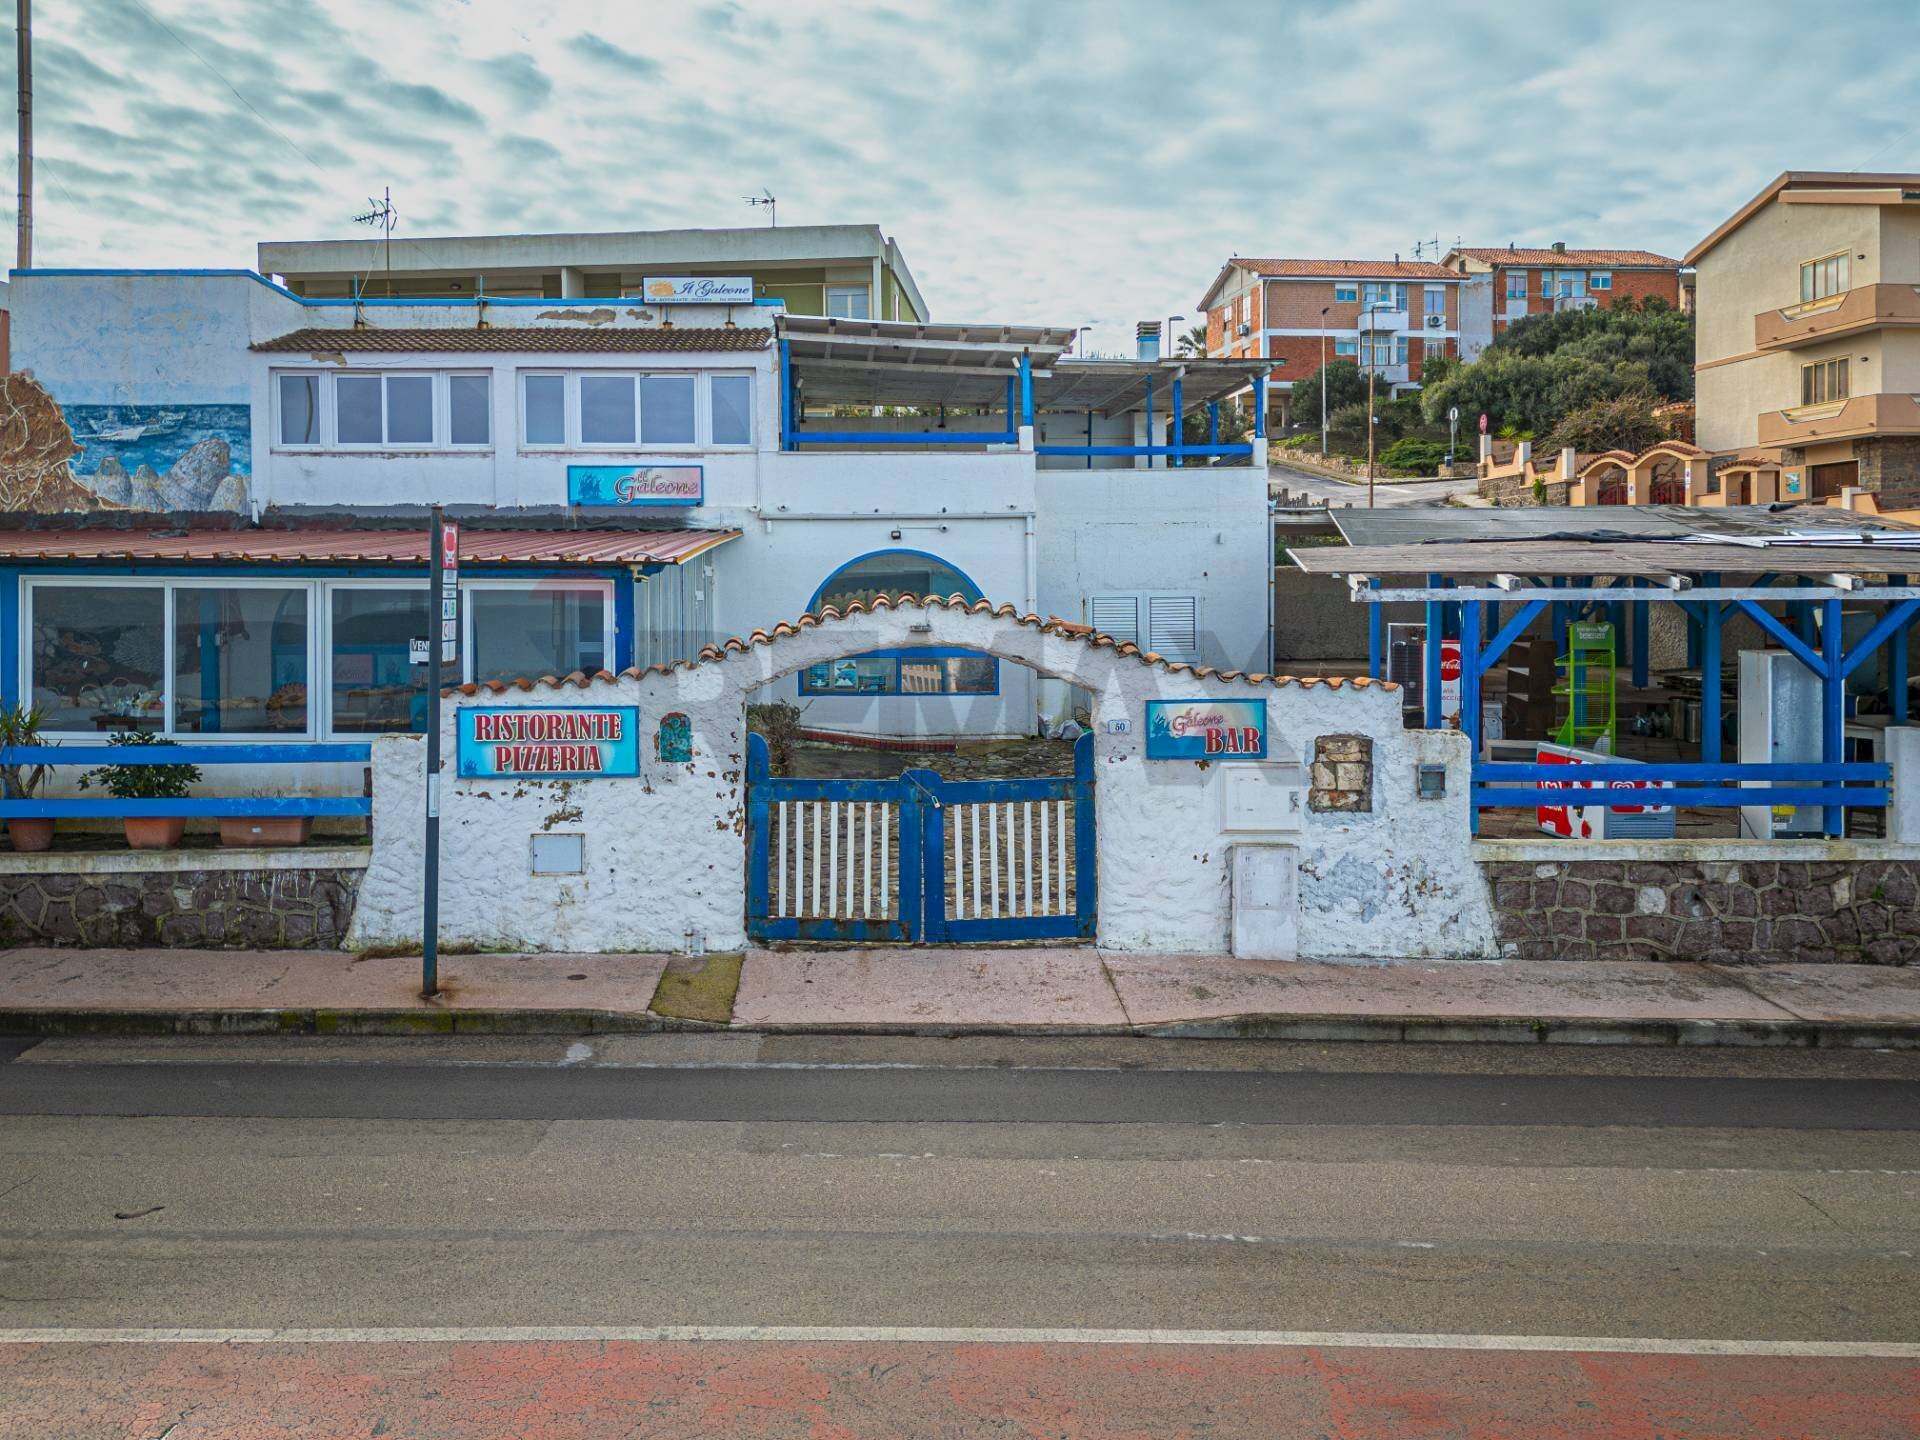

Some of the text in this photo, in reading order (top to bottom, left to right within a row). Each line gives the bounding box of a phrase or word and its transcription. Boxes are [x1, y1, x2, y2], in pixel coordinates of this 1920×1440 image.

[695, 279, 750, 297] Galeone
[614, 474, 699, 504] Galeone
[411, 640, 430, 651] VEN
[474, 713, 622, 742] RISTORANTE
[1114, 722, 1126, 732] 50
[1205, 727, 1260, 755] BAR
[494, 745, 603, 773] PIZZERIA
